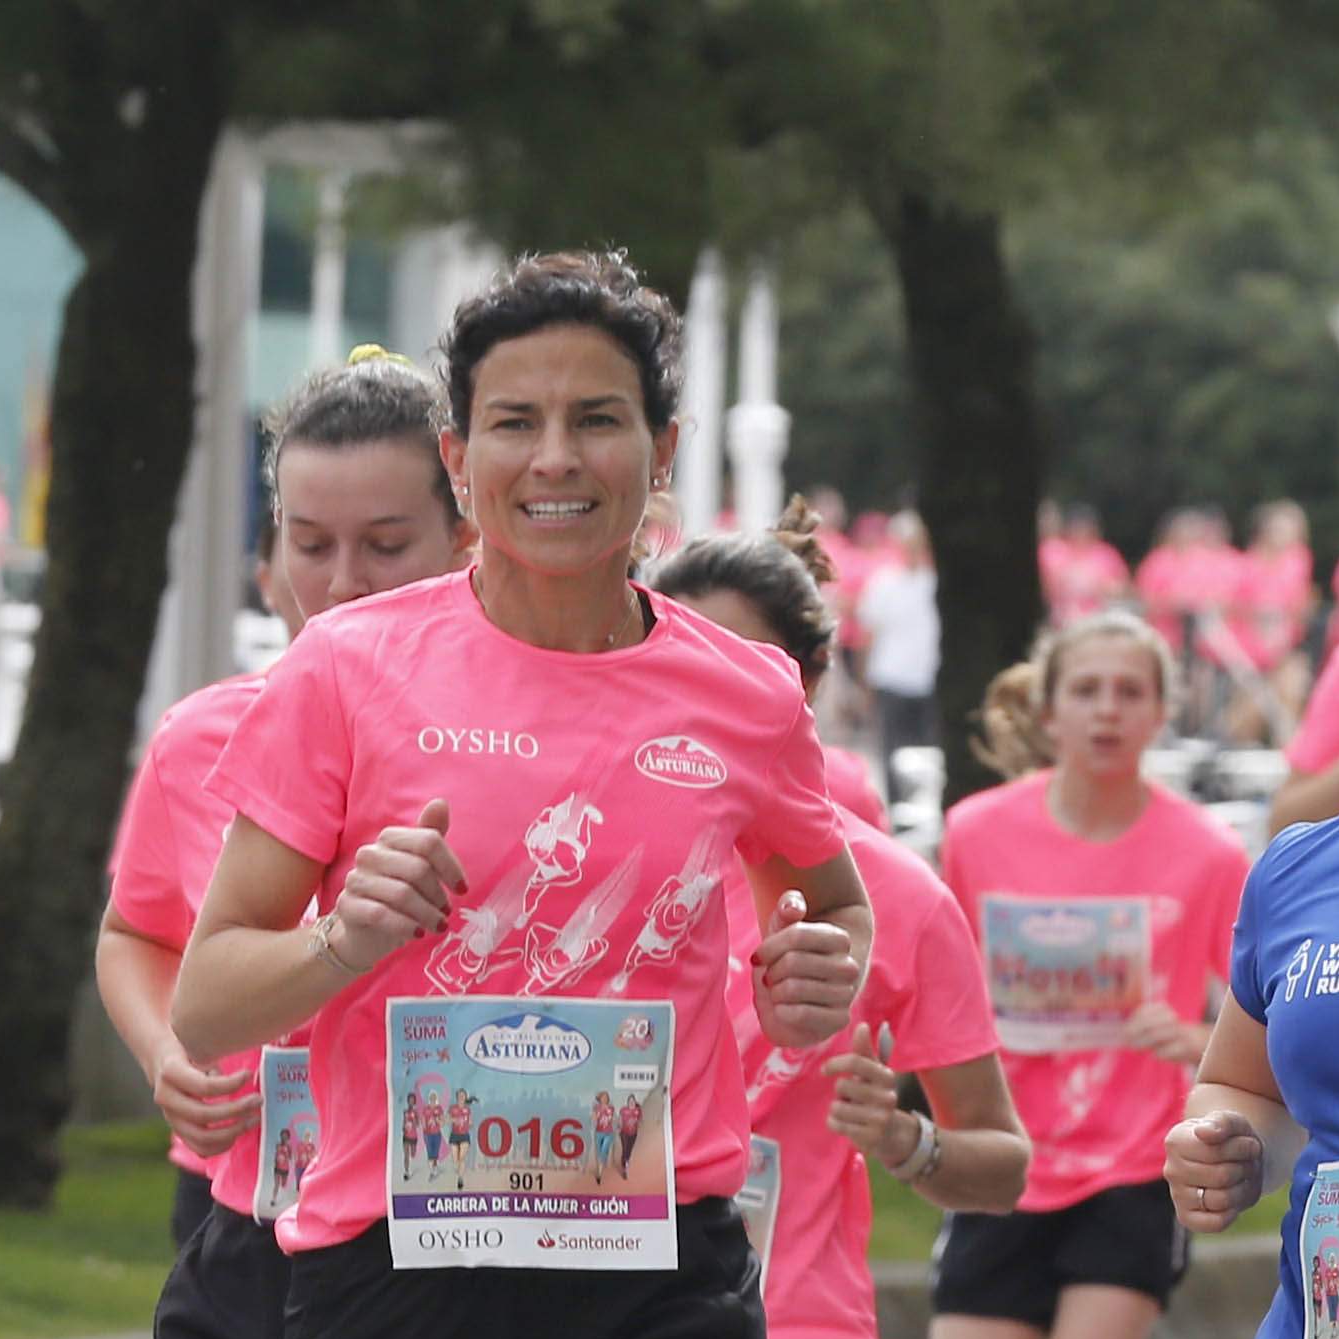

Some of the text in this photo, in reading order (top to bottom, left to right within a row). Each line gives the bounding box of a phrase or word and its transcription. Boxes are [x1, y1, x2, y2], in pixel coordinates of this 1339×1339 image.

[417, 725, 539, 759] OYSHO
[643, 749, 721, 780] ASTURIANA
[404, 1025, 446, 1040] SUMA
[622, 1018, 649, 1039] 20
[474, 1035, 581, 1060] ASTURIANA
[477, 1116, 585, 1160] 016
[509, 1172, 544, 1191] 901
[427, 1196, 628, 1215] CARRERA DE LA MUJER GIJÓN
[418, 1228, 503, 1250] OYSHO
[559, 1232, 642, 1250] Santander
